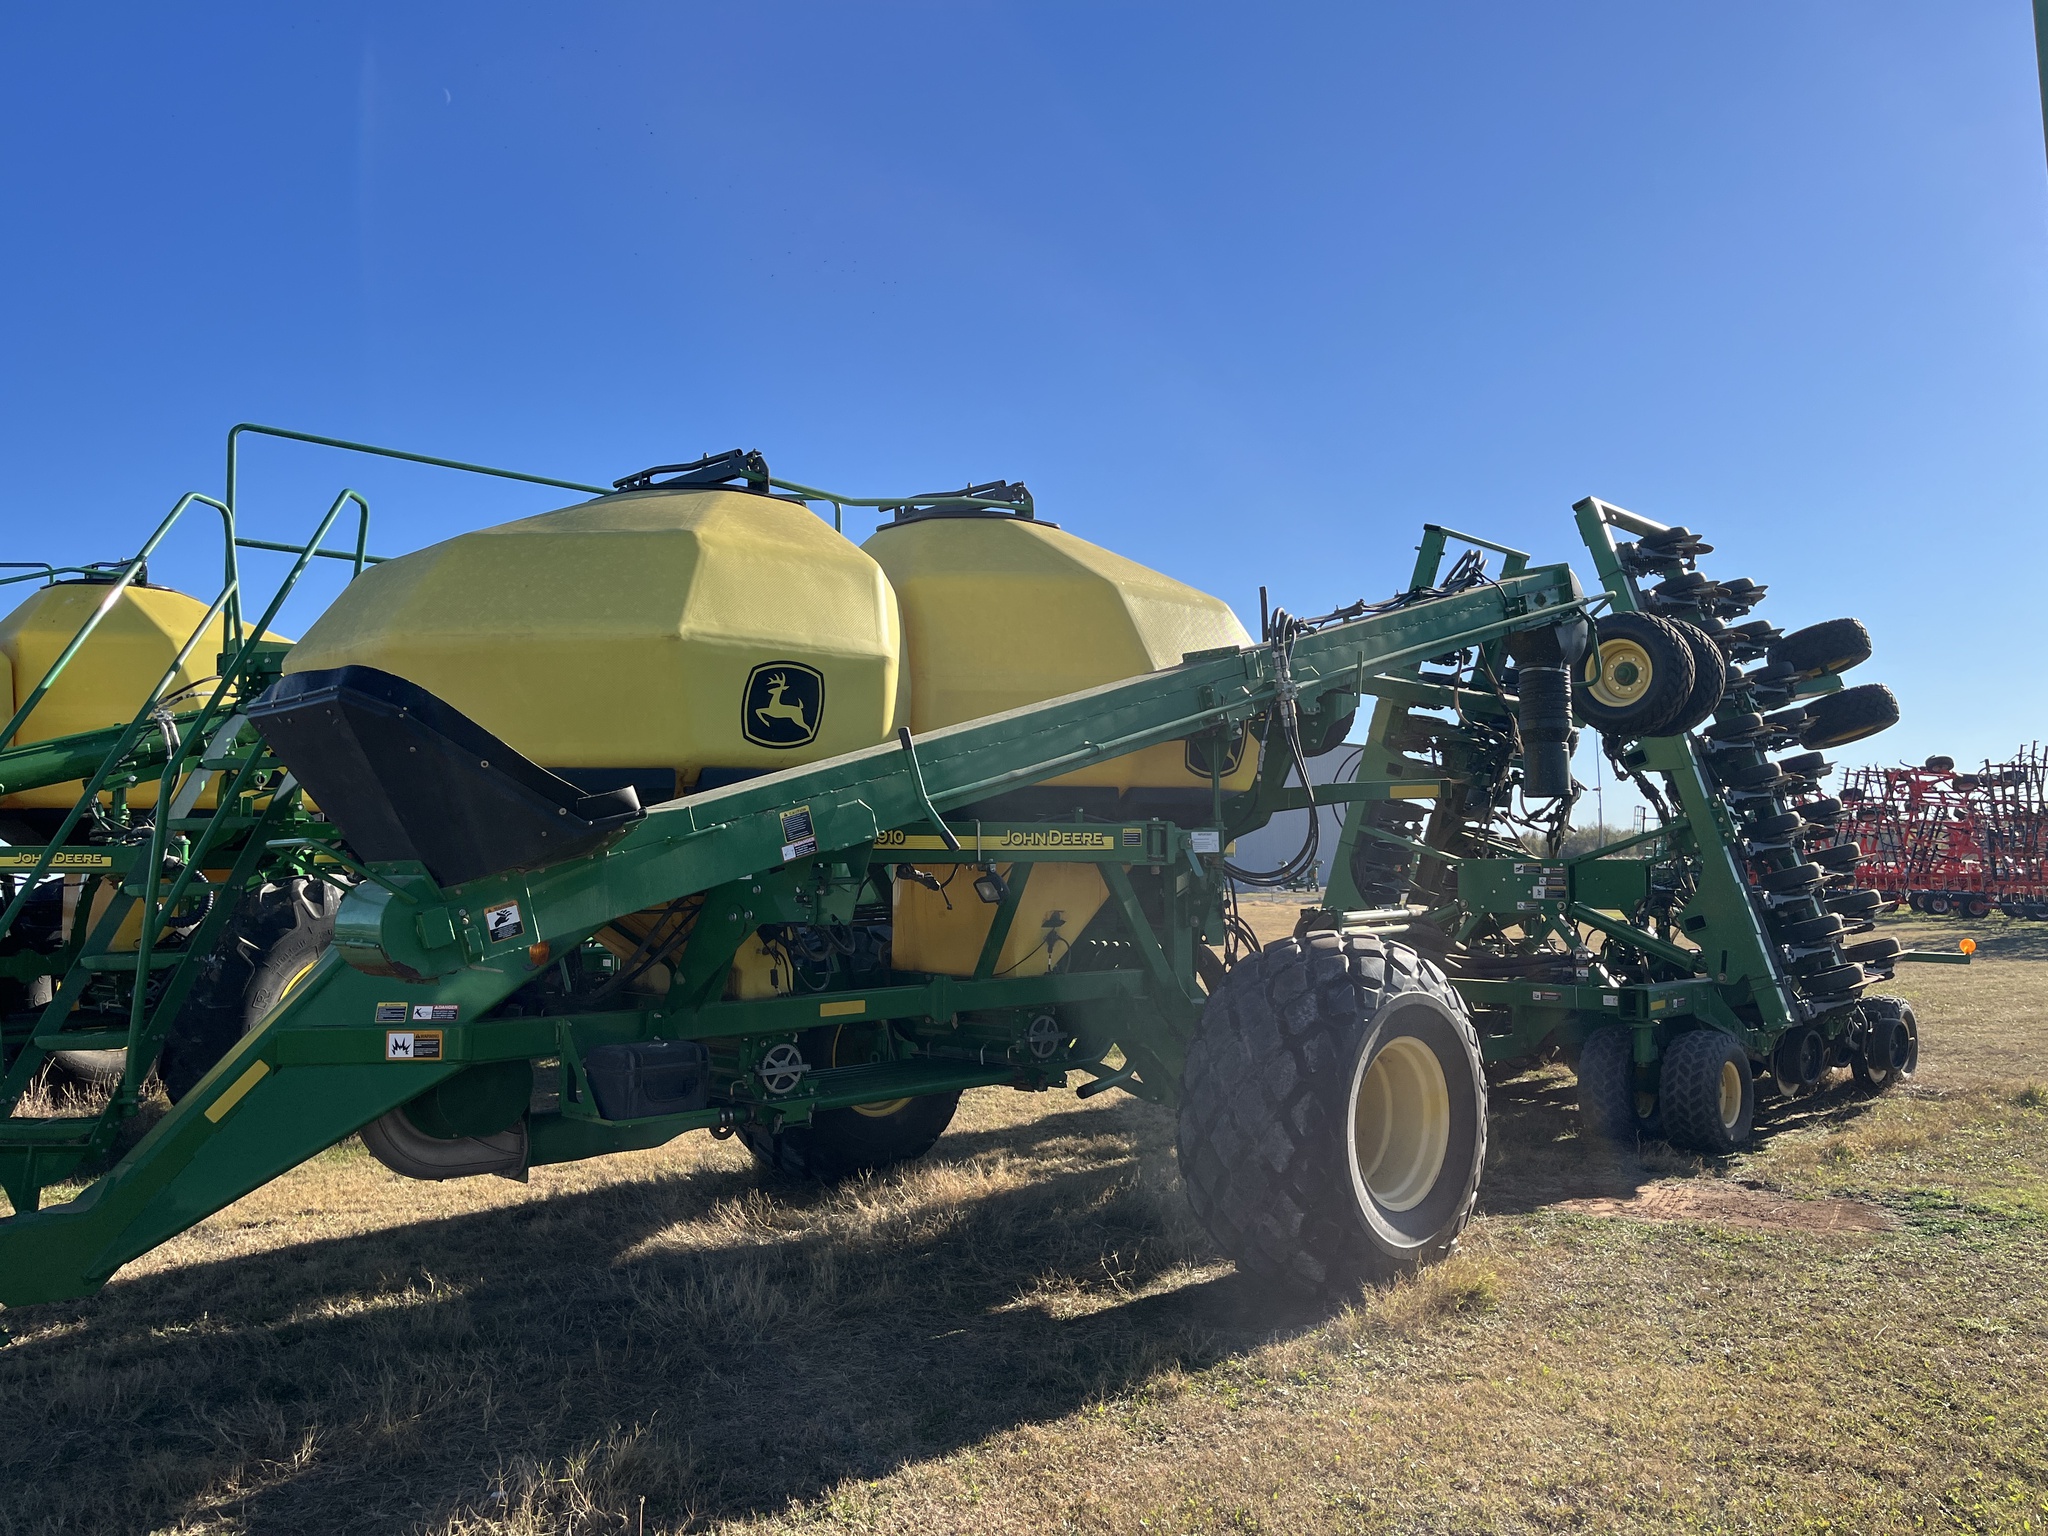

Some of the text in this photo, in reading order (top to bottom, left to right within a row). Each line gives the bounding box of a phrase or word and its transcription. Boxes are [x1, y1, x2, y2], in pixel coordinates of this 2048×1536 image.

[876, 830, 905, 845] 910
[1001, 829, 1104, 845] JOHN DEERE
[14, 852, 102, 864] JOH DEERE
